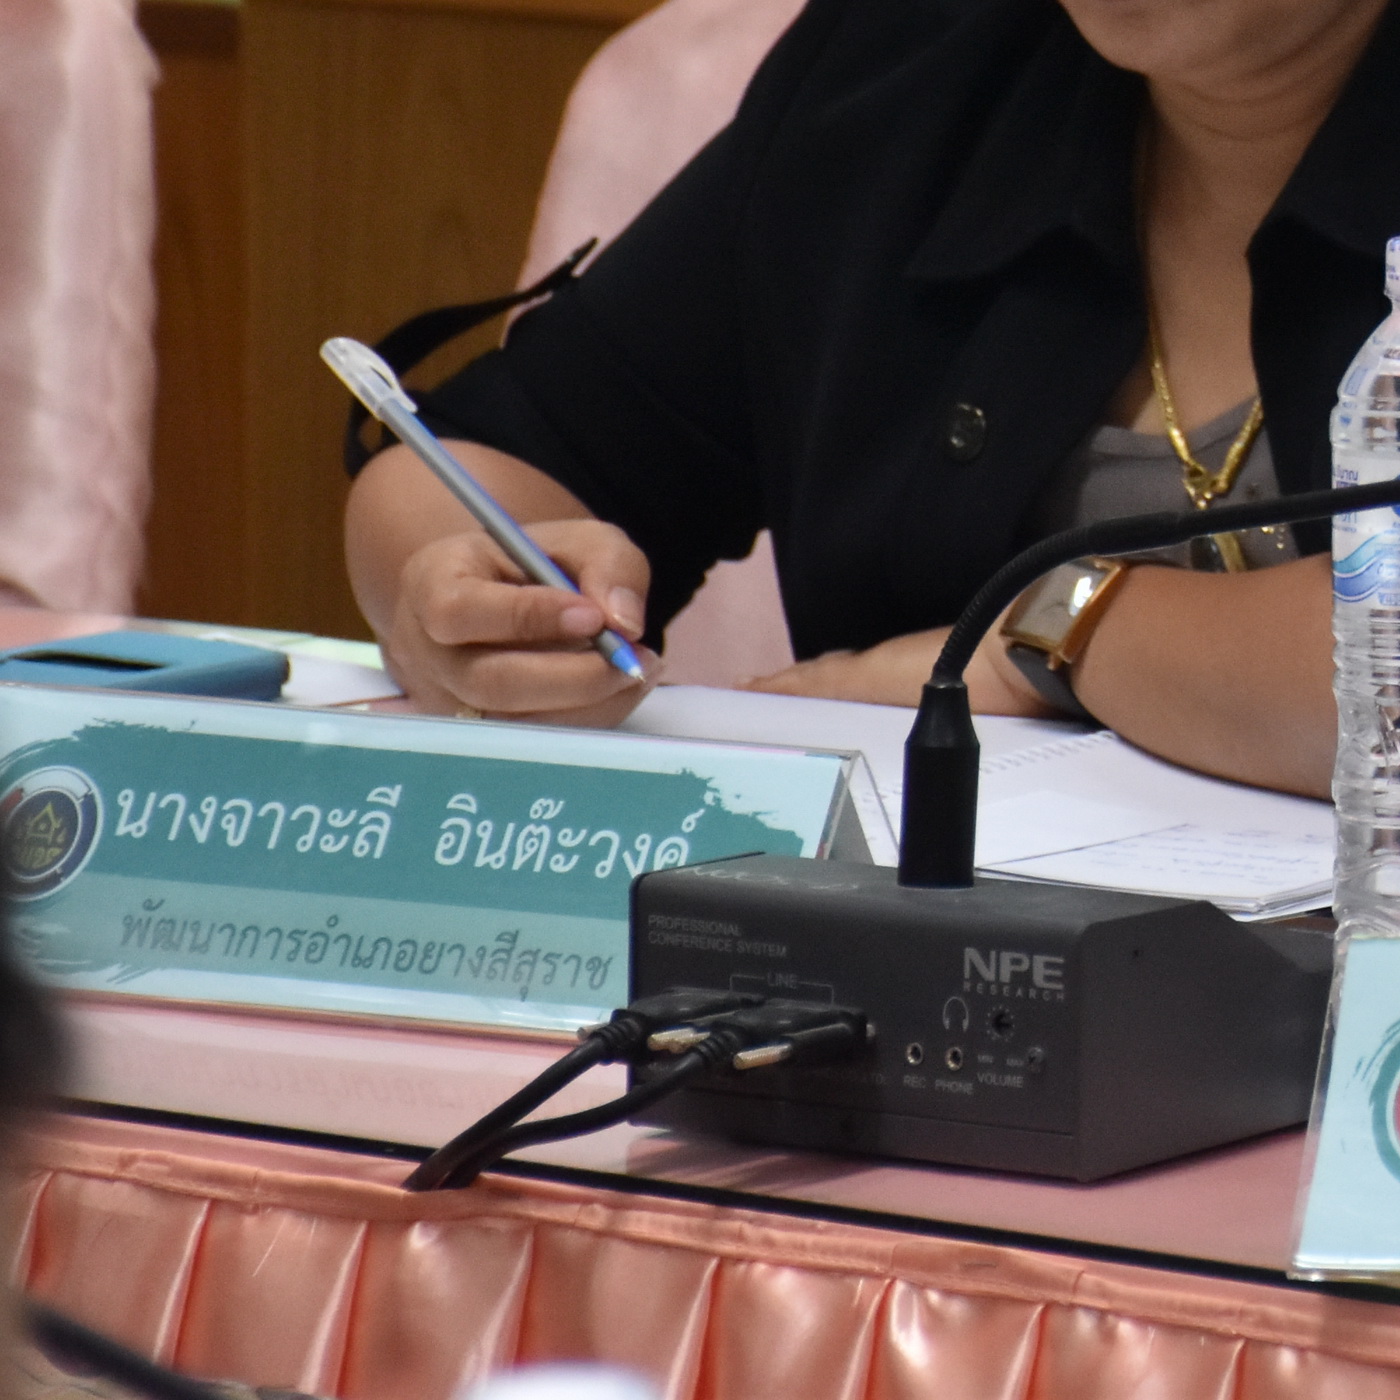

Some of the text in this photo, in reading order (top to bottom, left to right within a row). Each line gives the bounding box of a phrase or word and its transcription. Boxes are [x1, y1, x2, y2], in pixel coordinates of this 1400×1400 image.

[115, 784, 402, 859] นางจาวะลี
[648, 914, 741, 937] PROFESSIONAL
[119, 898, 613, 1002] พัฒนาการอำเภอยางสีสุราช
[648, 931, 787, 958] CONFERENCE SYSTEM
[963, 947, 1066, 990] NPE
[767, 971, 798, 990] LINE
[963, 980, 1066, 1001] RESEARCH
[903, 1074, 927, 1089] REC
[935, 1078, 974, 1095] PHONE
[977, 1072, 1025, 1088] VOLUME
